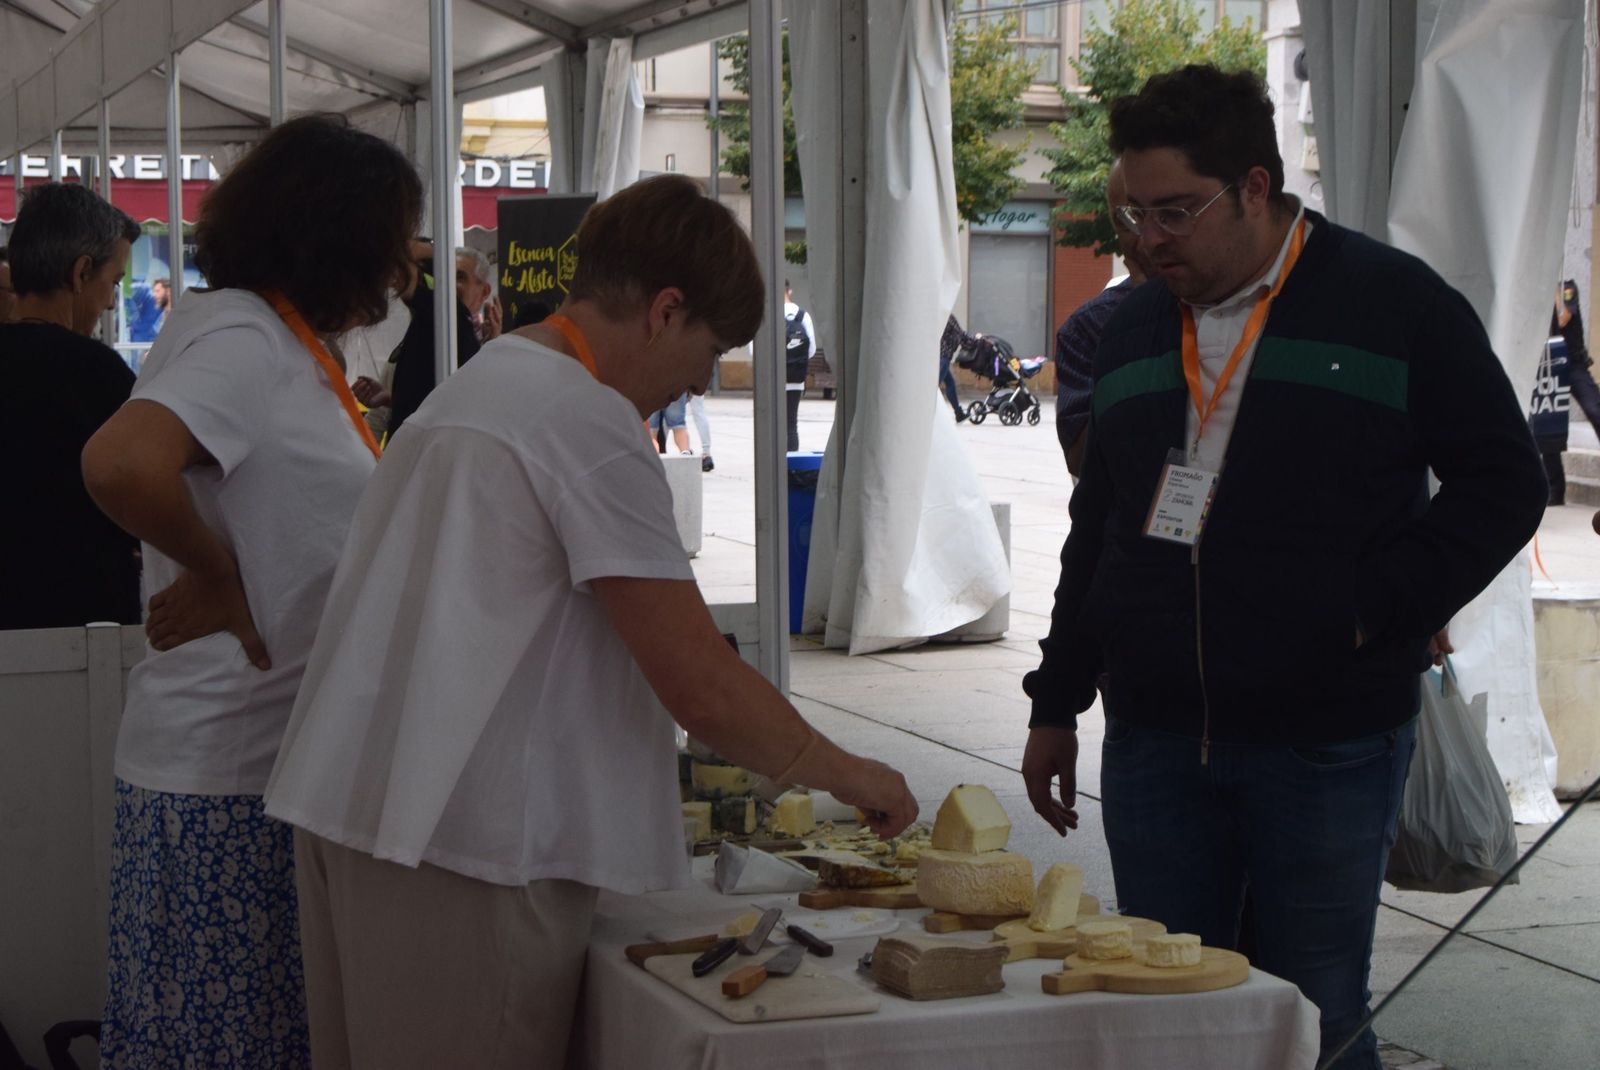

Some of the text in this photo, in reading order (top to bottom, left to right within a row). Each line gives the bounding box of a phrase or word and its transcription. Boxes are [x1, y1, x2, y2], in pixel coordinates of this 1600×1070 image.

[0, 154, 221, 180] ERRET
[508, 240, 554, 267] Esencia
[501, 269, 513, 286] de
